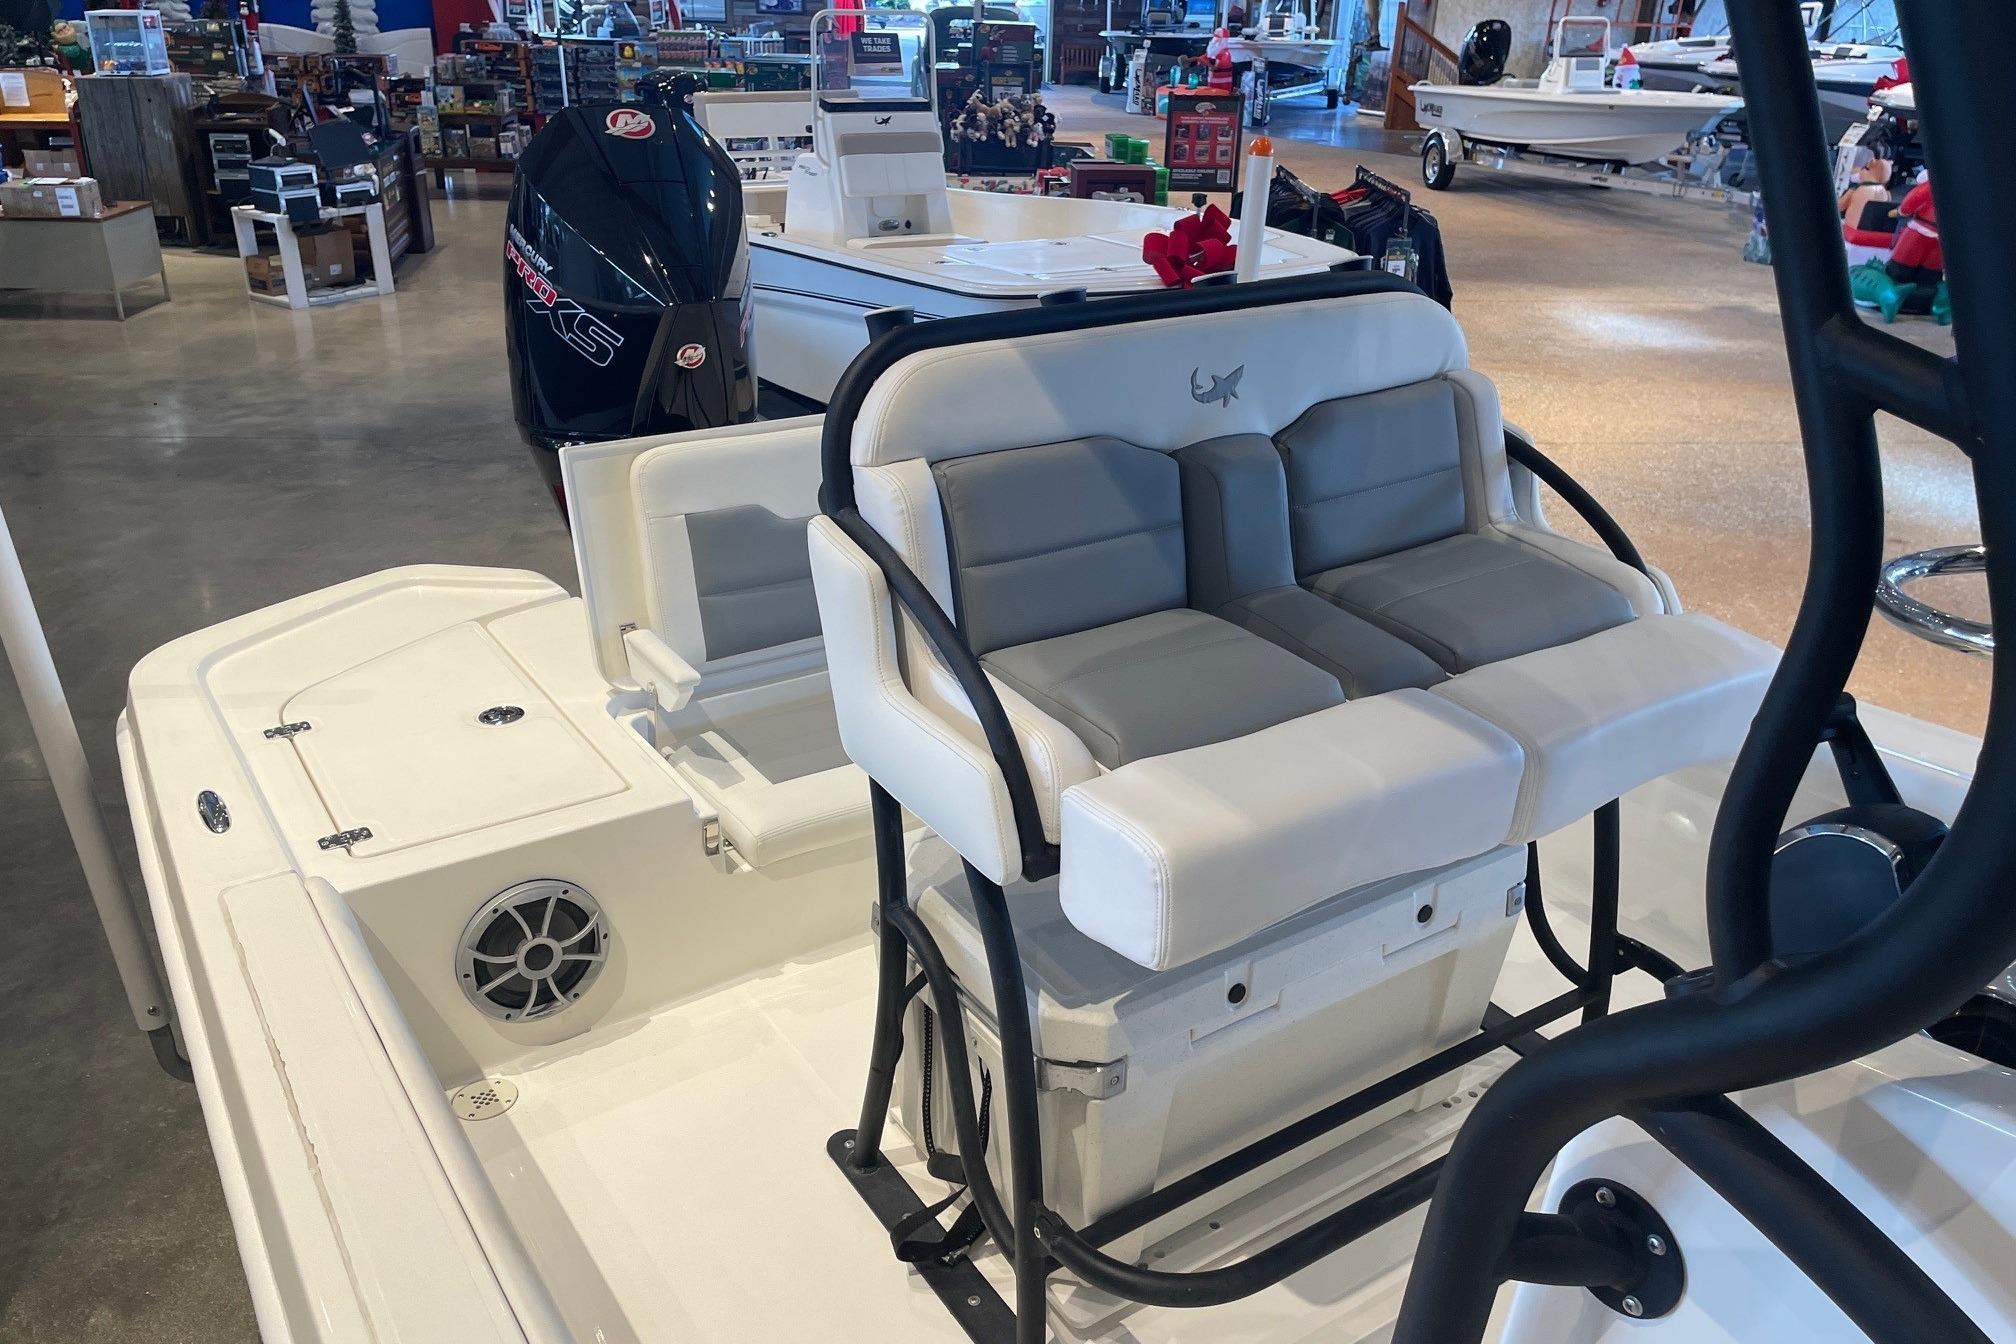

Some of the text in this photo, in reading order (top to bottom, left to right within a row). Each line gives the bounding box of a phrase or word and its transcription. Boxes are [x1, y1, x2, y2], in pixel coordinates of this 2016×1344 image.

[506, 239, 558, 308] PRO
[509, 223, 554, 275] MERCURY
[525, 298, 625, 367] XS
